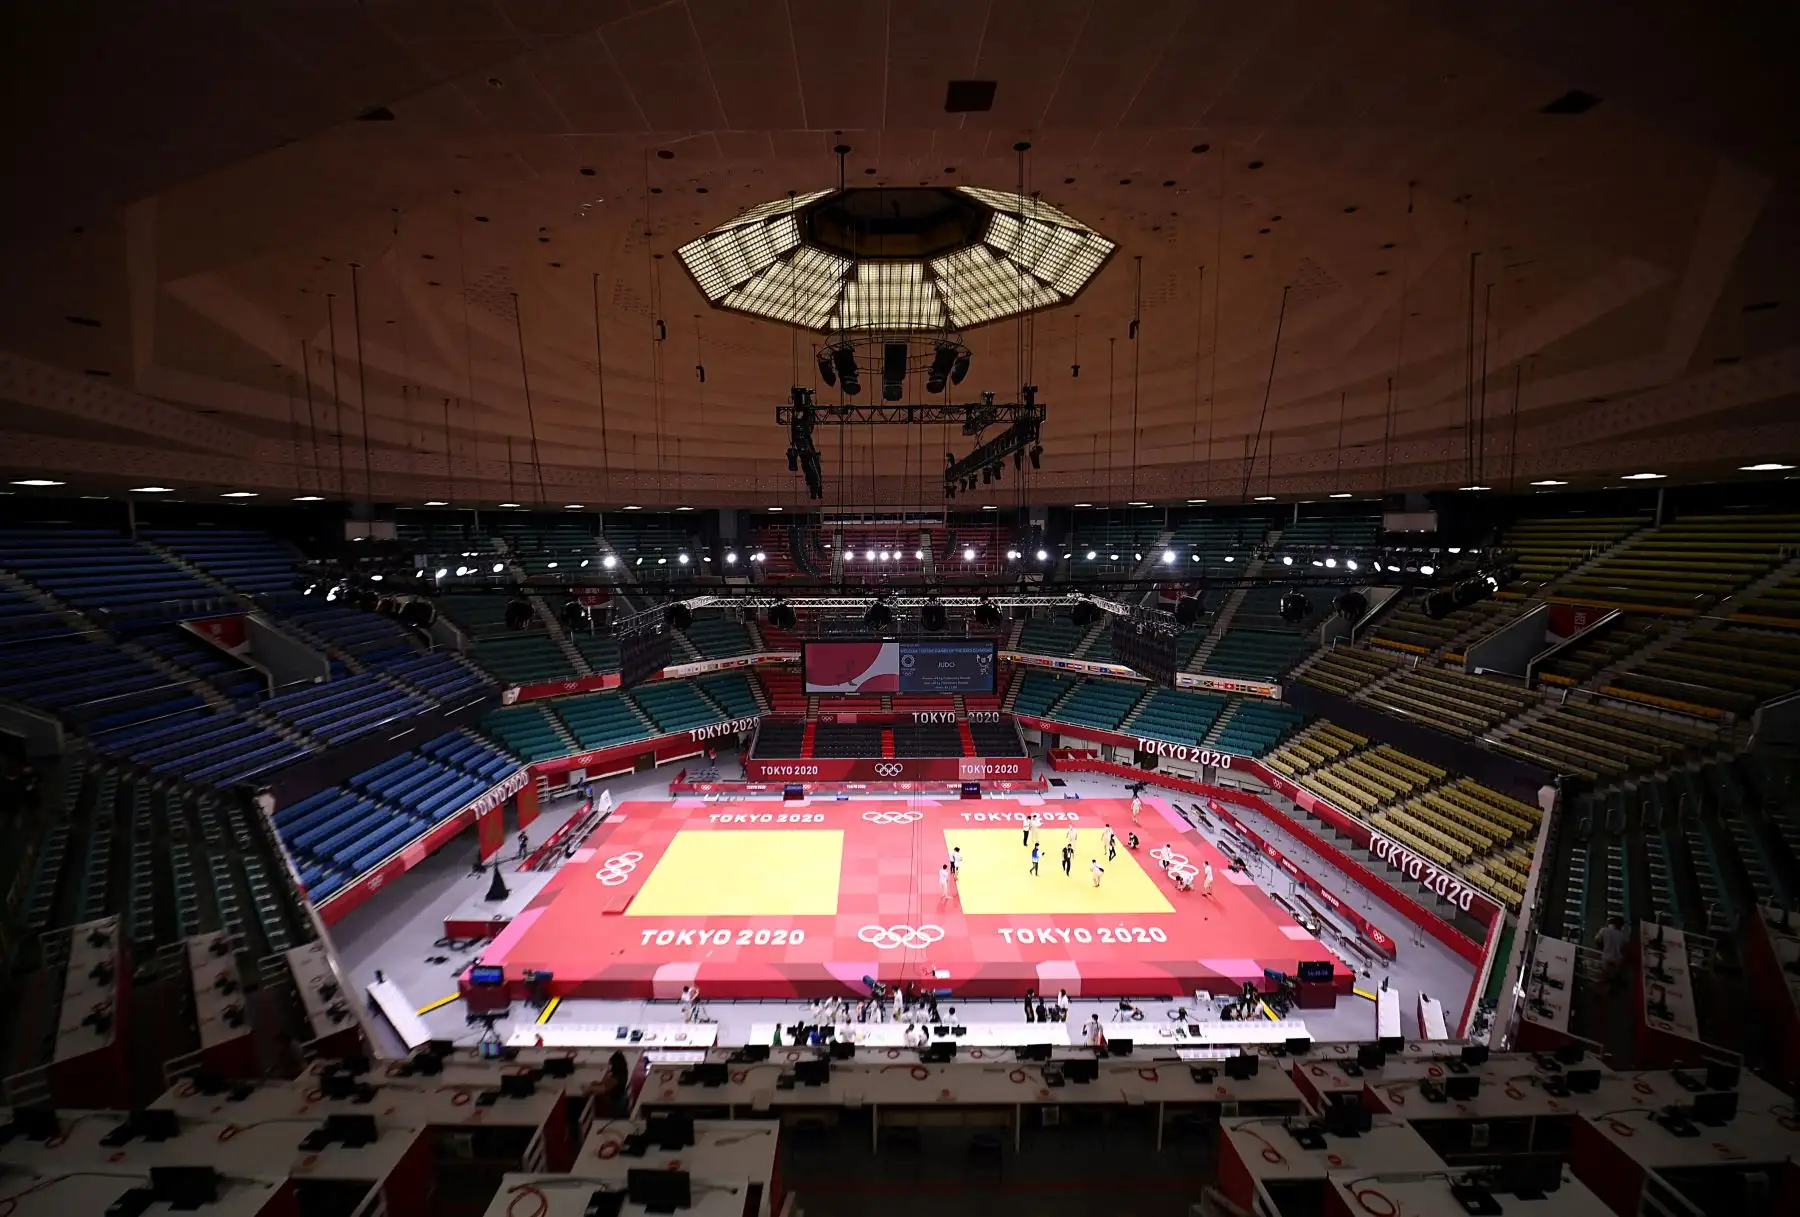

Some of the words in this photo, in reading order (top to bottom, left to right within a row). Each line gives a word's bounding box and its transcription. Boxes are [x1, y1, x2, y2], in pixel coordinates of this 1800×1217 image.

[912, 712, 955, 724] TOKYO
[968, 711, 1000, 724] 2020
[689, 723, 730, 743] TOKYO
[732, 716, 760, 733] 2020
[1137, 738, 1187, 760] TOKYO
[1190, 749, 1231, 769] 2020
[761, 766, 793, 775] TOKYO
[794, 766, 818, 775] 2020
[961, 764, 993, 774] TOKYO
[994, 764, 1019, 774] 2020
[470, 788, 506, 820] TOKYO
[504, 770, 529, 798] 2020
[709, 813, 773, 823] TOKYO
[776, 813, 825, 823] 2020
[960, 812, 1025, 822] TOKYO
[1030, 811, 1080, 822] 2020
[1369, 831, 1422, 880] TOKYO
[1423, 868, 1474, 911] 2020
[640, 928, 732, 946] TOKYO
[735, 928, 805, 946] 2020
[997, 927, 1093, 944] TOKYO
[1097, 926, 1168, 943] 2020
